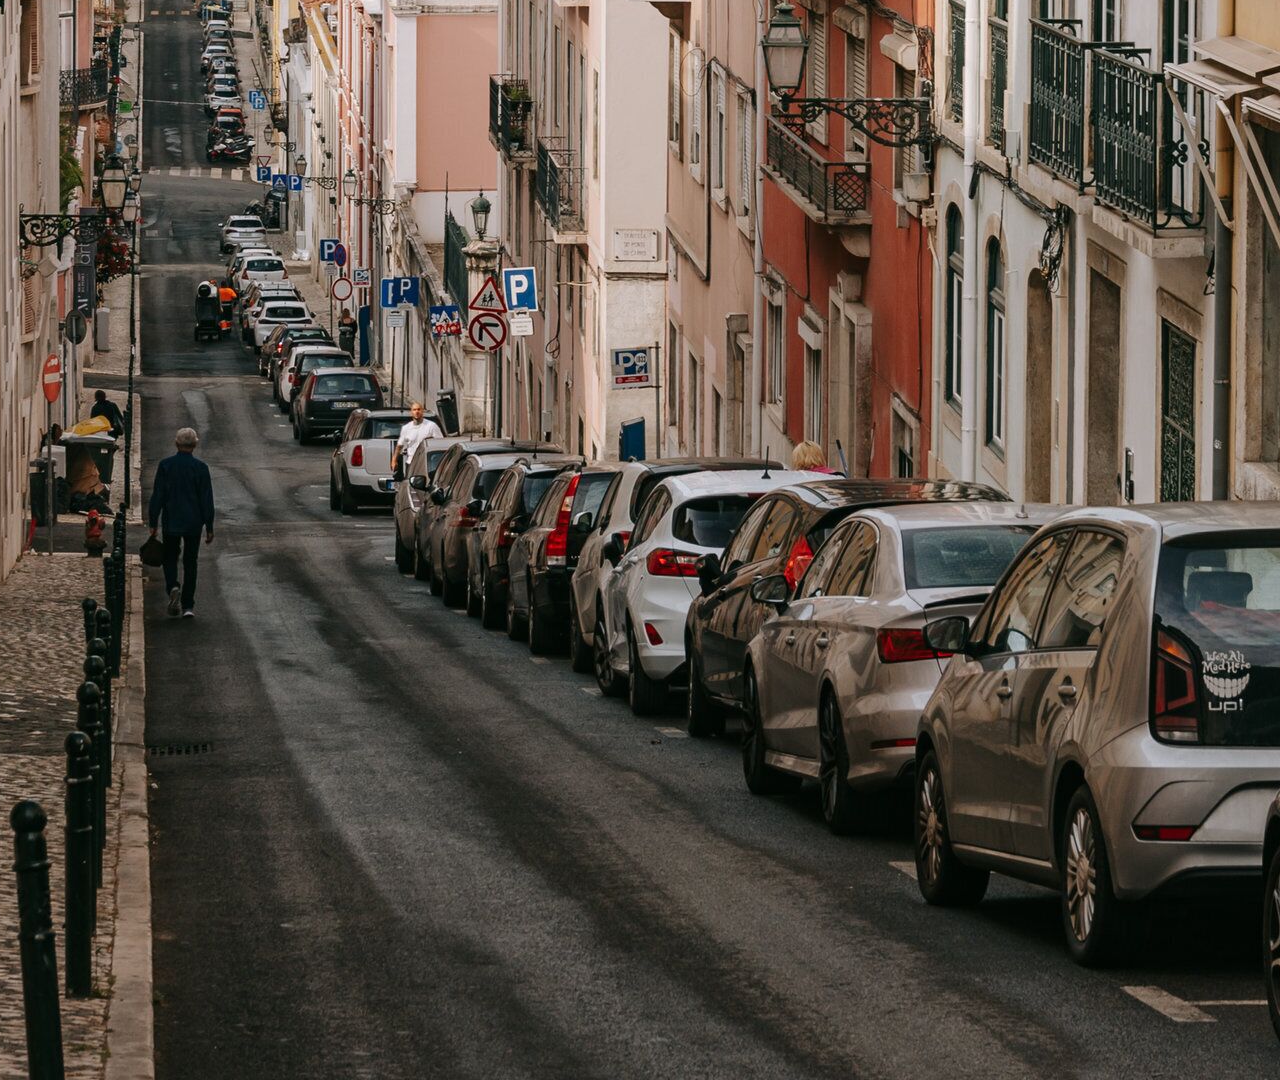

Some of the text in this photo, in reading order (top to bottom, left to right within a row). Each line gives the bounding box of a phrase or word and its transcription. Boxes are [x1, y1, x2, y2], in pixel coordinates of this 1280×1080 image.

[260, 169, 268, 179] P
[291, 177, 299, 187] P
[323, 241, 335, 259] P
[400, 278, 411, 296] P
[510, 274, 528, 306] P
[618, 352, 634, 371] P
[1202, 659, 1251, 674] Mad Here
[1208, 698, 1243, 714] up!
